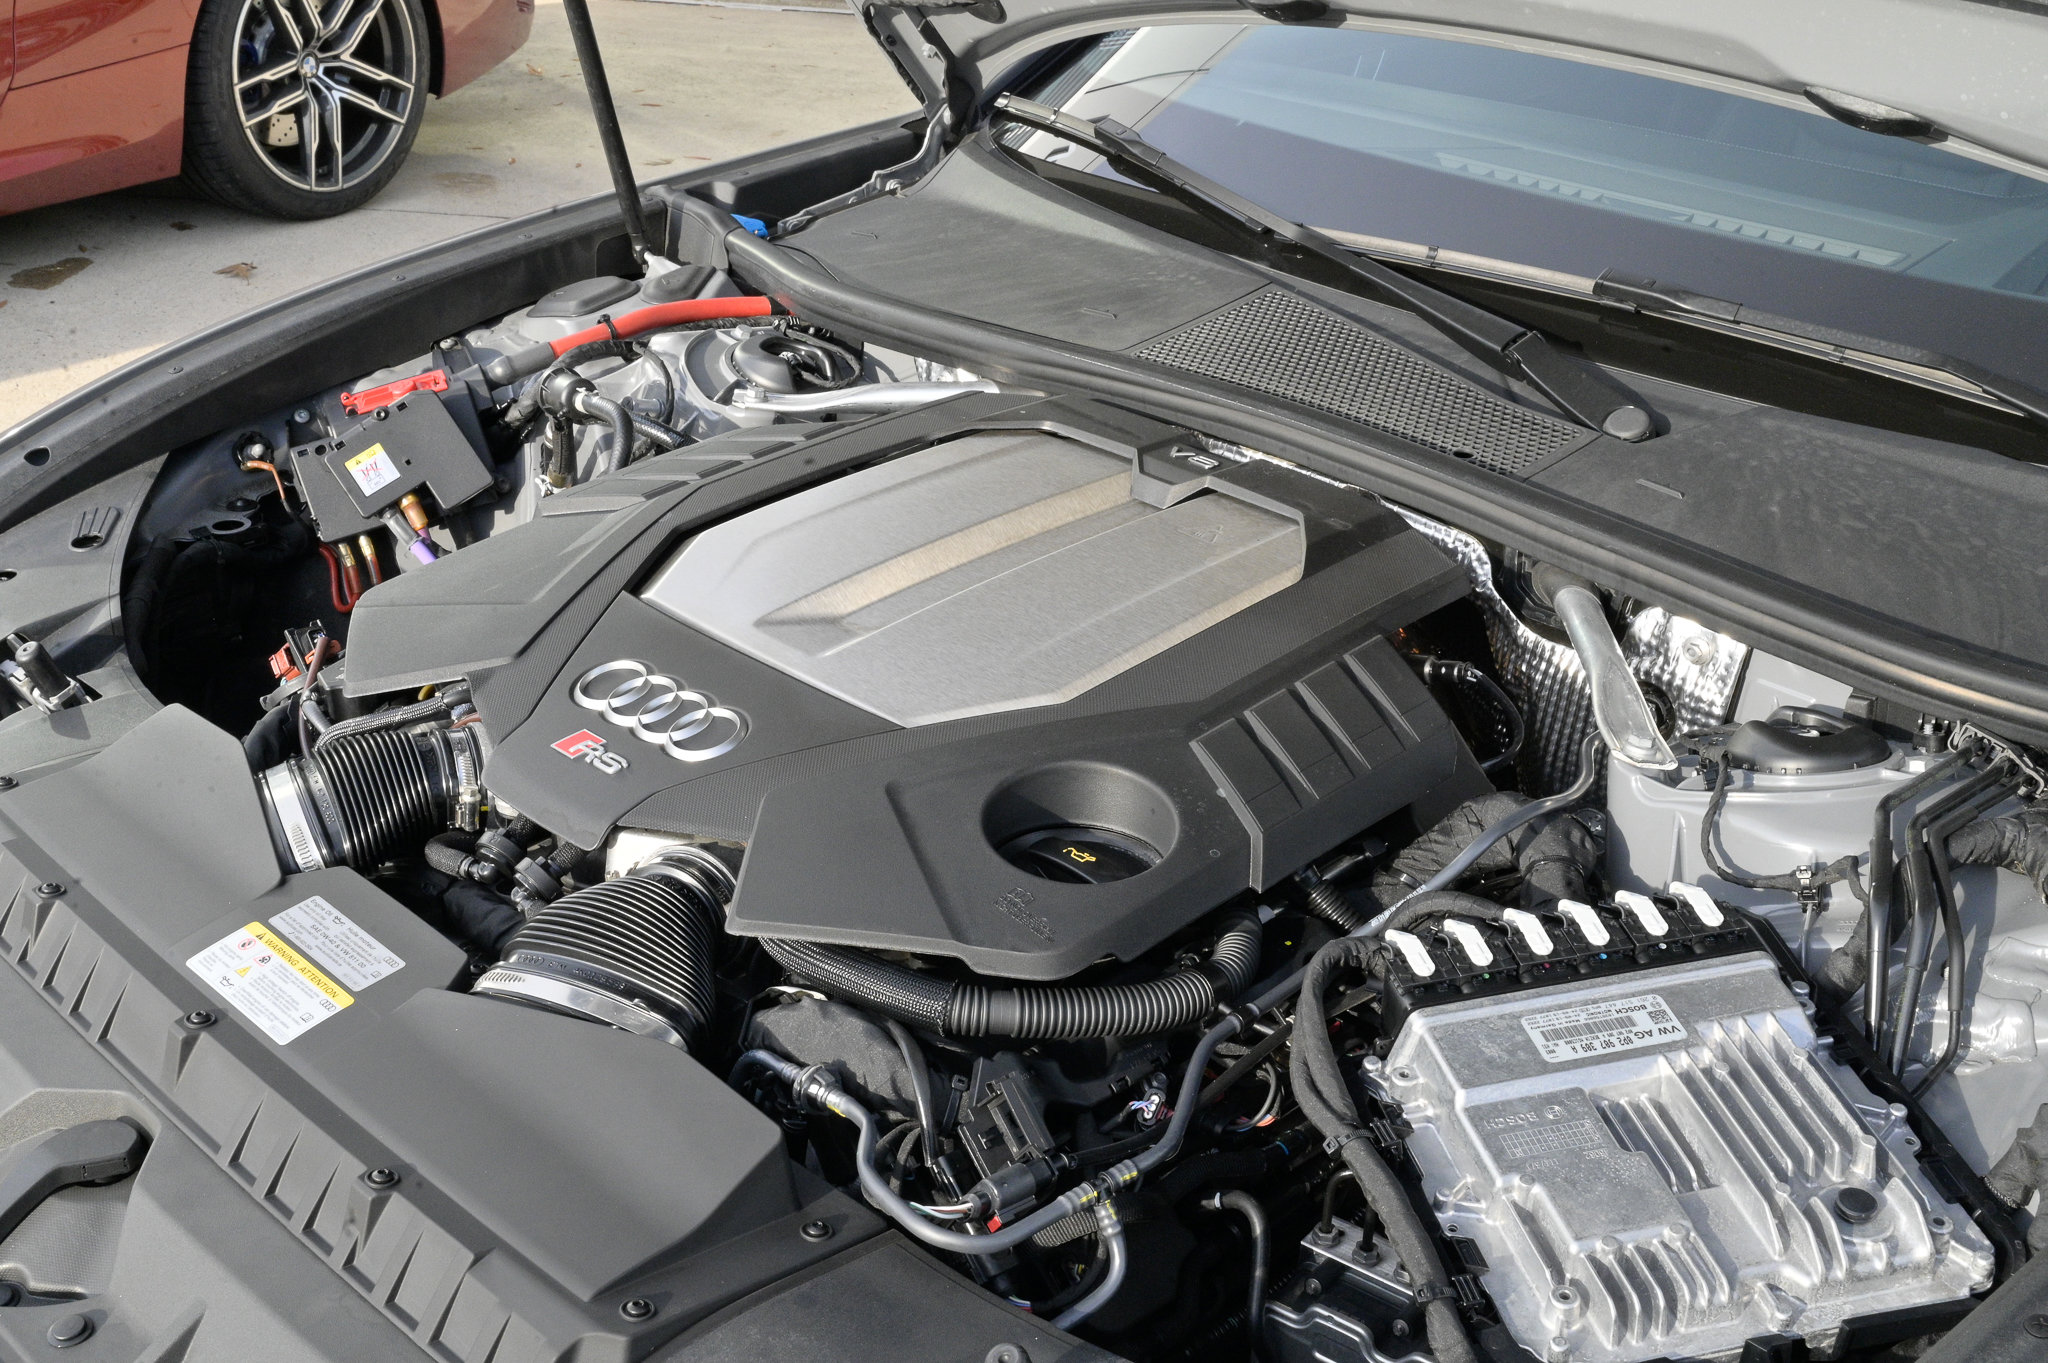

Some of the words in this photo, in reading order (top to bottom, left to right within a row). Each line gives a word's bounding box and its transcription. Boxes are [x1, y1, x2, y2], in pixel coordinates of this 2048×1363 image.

[564, 736, 630, 775] RS
[310, 898, 326, 912] Engine
[310, 924, 322, 933] SAE
[358, 936, 377, 950] moteur
[264, 938, 300, 966] WARNING
[298, 967, 339, 998] ATTENTION
[1614, 1004, 1648, 1015] BOSCH
[1634, 1029, 1653, 1039] AG
[1657, 1025, 1681, 1036] VW
[1484, 1112, 1538, 1128] BOSCH
